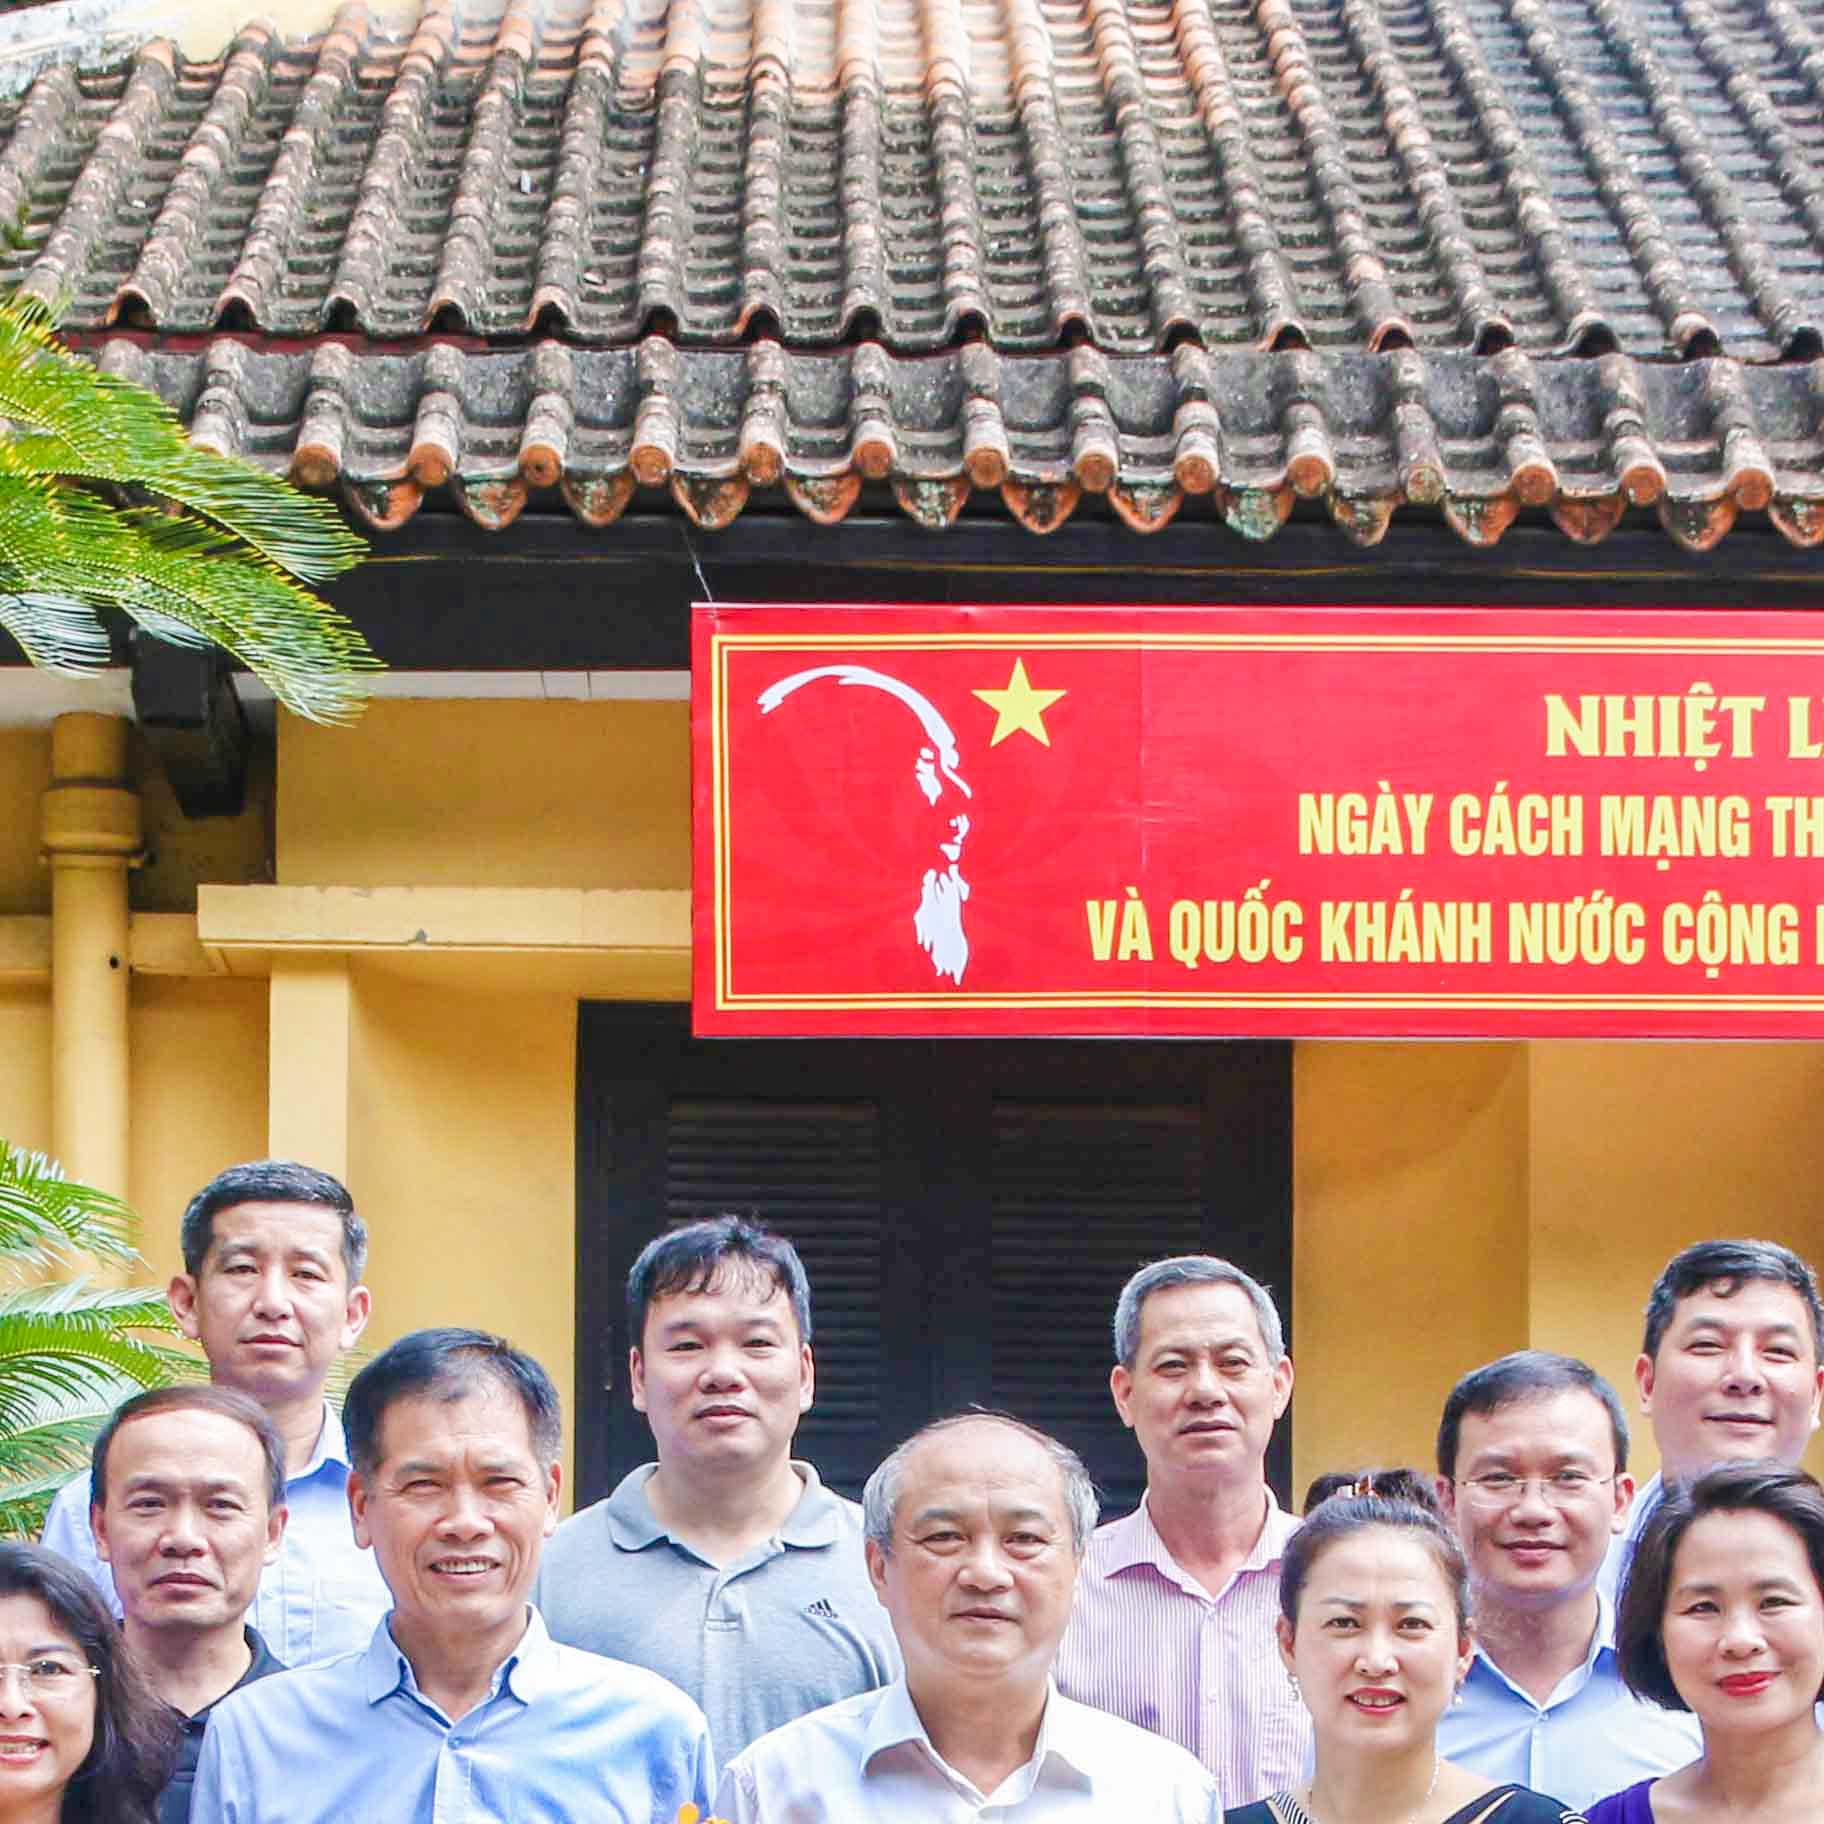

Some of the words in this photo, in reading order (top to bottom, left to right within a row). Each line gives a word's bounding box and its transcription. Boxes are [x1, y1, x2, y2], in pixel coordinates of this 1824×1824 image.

[1544, 681, 1766, 773] NHIỆT
[1299, 780, 1434, 856] NGÀY
[1449, 781, 1584, 858] CÁCH
[1600, 795, 1750, 871] MẠNG
[1086, 886, 1153, 962] VÀ
[1169, 877, 1303, 970] QUỐC
[1321, 887, 1492, 964] KHÁNH
[1508, 888, 1645, 966] NƯỚC
[1663, 890, 1799, 978] CỘNG
